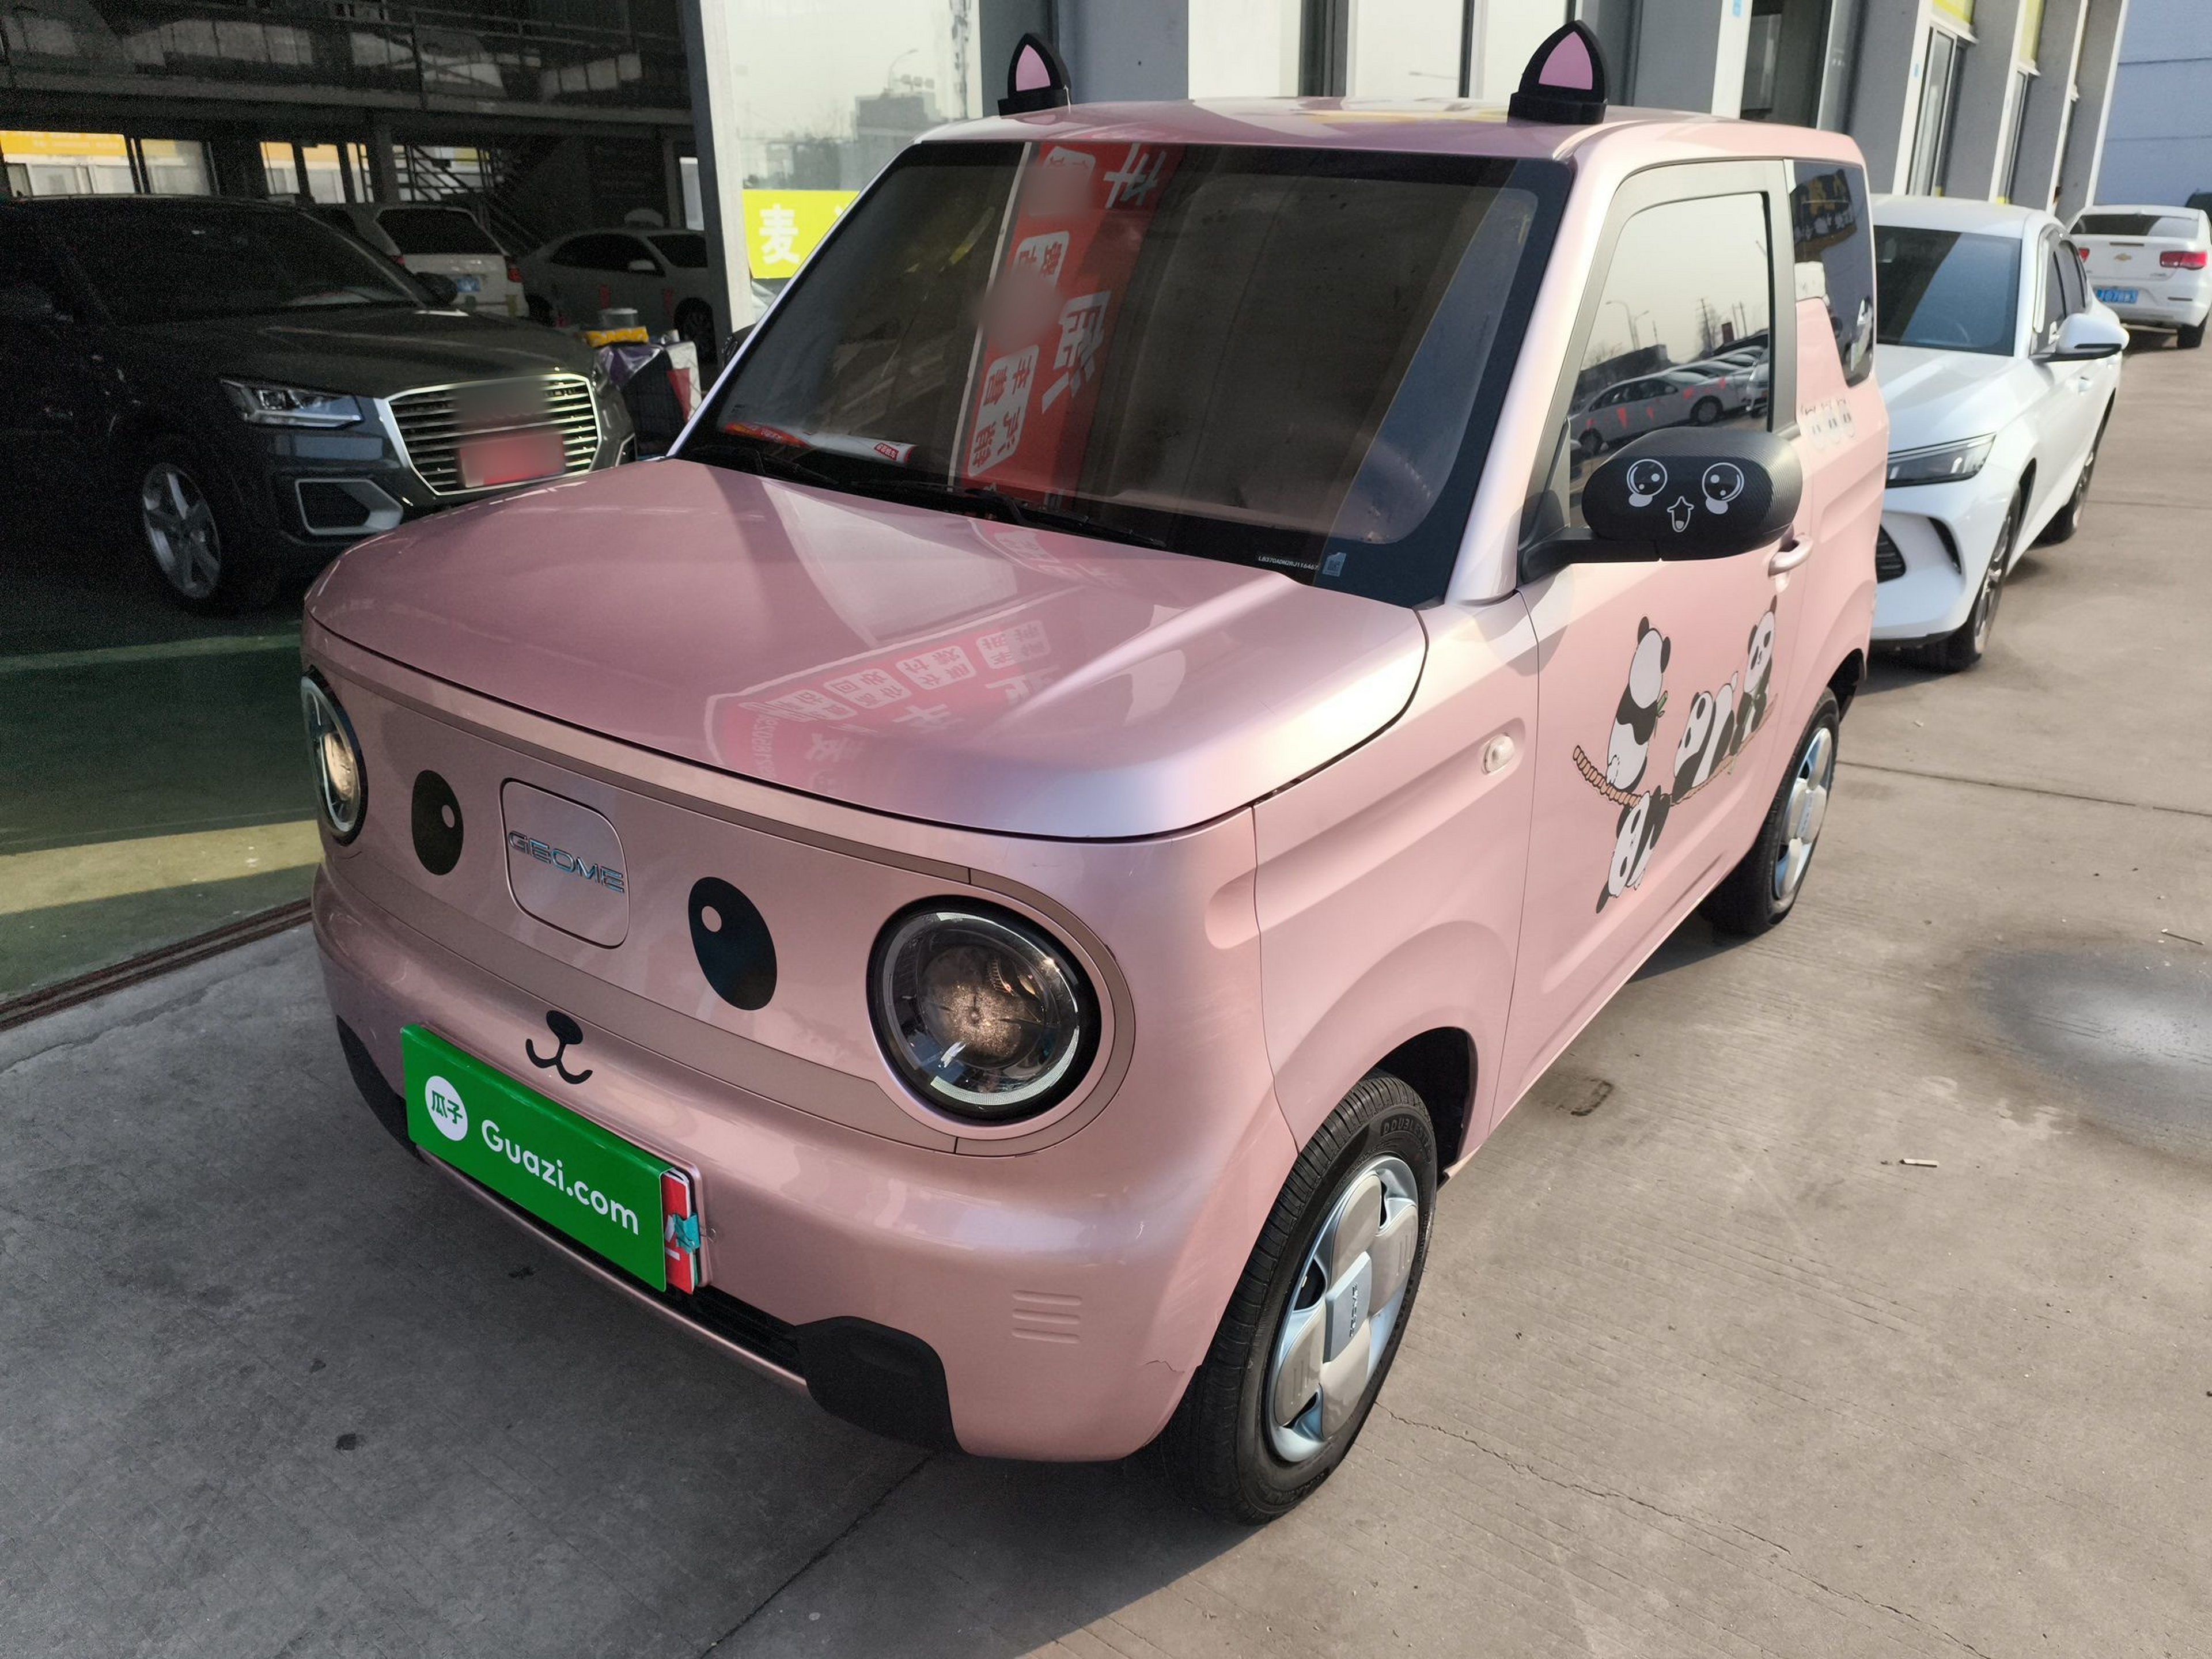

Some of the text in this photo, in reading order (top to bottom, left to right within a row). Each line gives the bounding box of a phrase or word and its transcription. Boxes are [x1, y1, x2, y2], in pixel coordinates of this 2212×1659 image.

[508, 830, 625, 893] GEOME
[431, 1090, 463, 1124] 瓜子
[482, 1119, 639, 1235] Guazi.com
